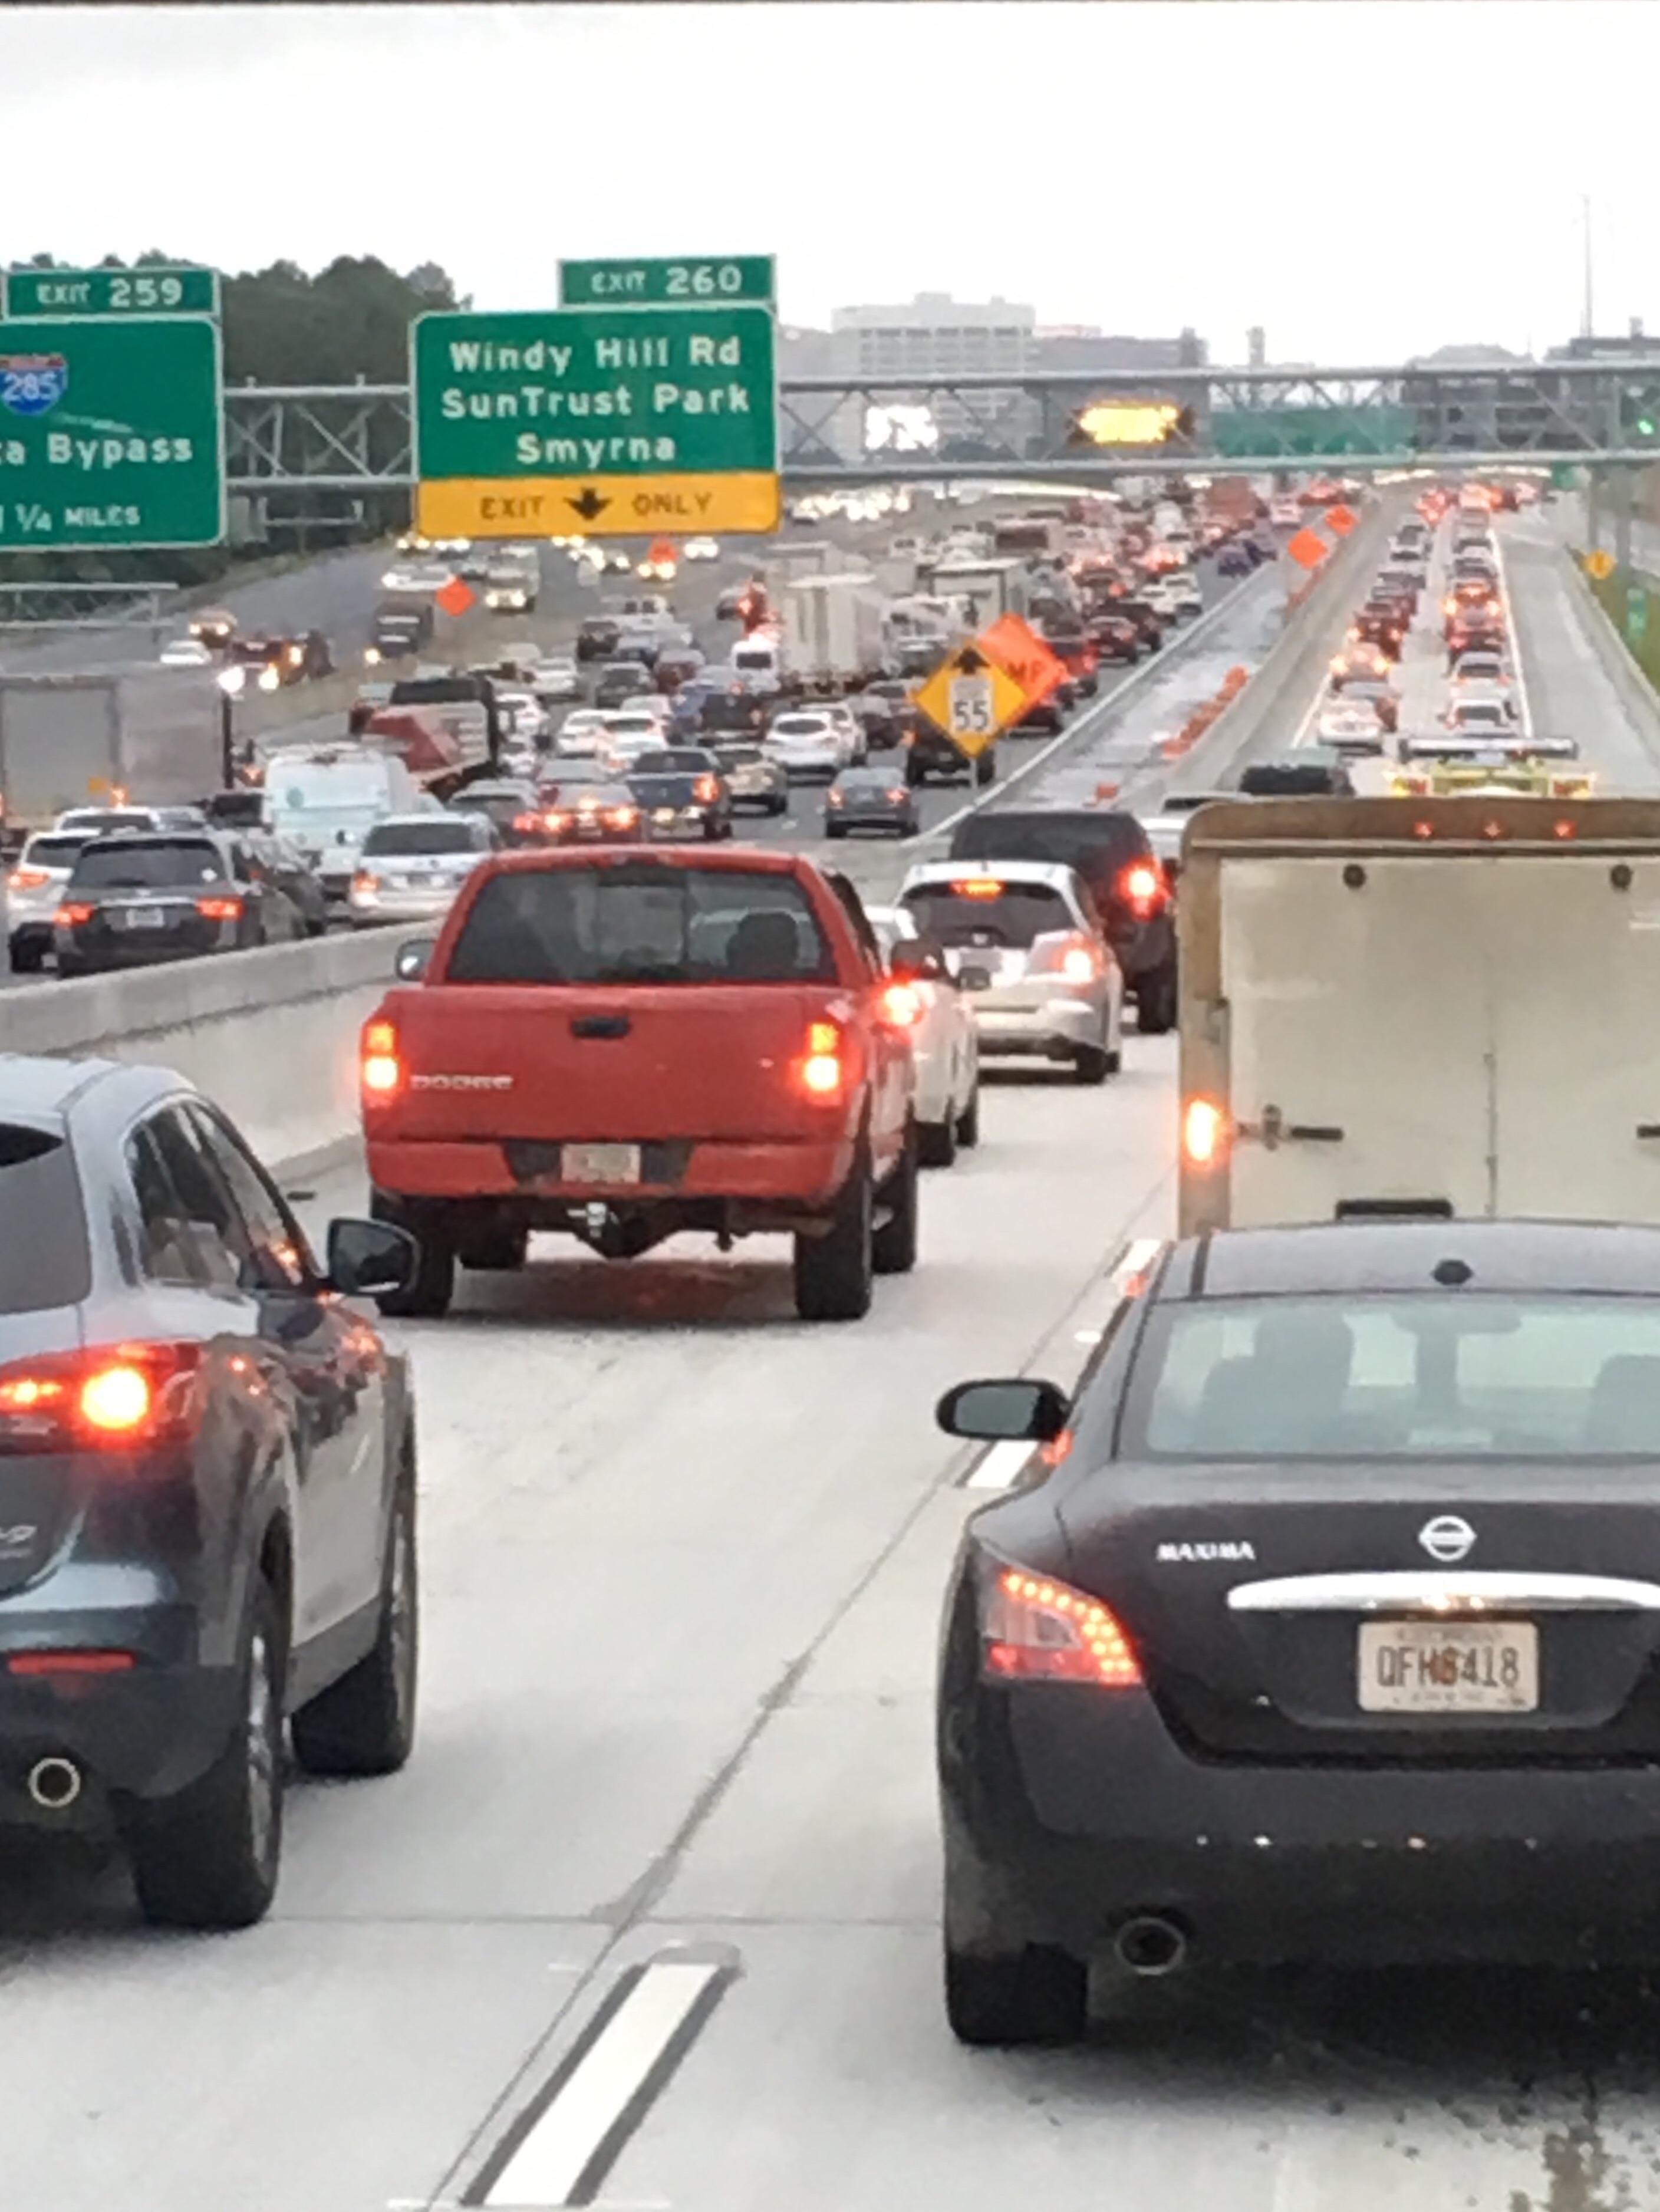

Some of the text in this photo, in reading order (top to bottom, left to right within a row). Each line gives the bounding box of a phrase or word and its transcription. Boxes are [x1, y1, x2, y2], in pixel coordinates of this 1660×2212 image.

[37, 278, 183, 307] EXIT 259
[591, 265, 743, 295] EXIT 260
[450, 335, 741, 376] Windy Hill Rd
[2, 371, 59, 400] 285
[442, 383, 750, 419] SunTrust Park
[47, 432, 193, 471] Bypass
[517, 432, 676, 469] Smyrna
[64, 505, 141, 526] MILES
[479, 492, 713, 519] EXIT ONLY
[953, 698, 989, 732] 55
[1156, 1540, 1257, 1562] MAXIMA
